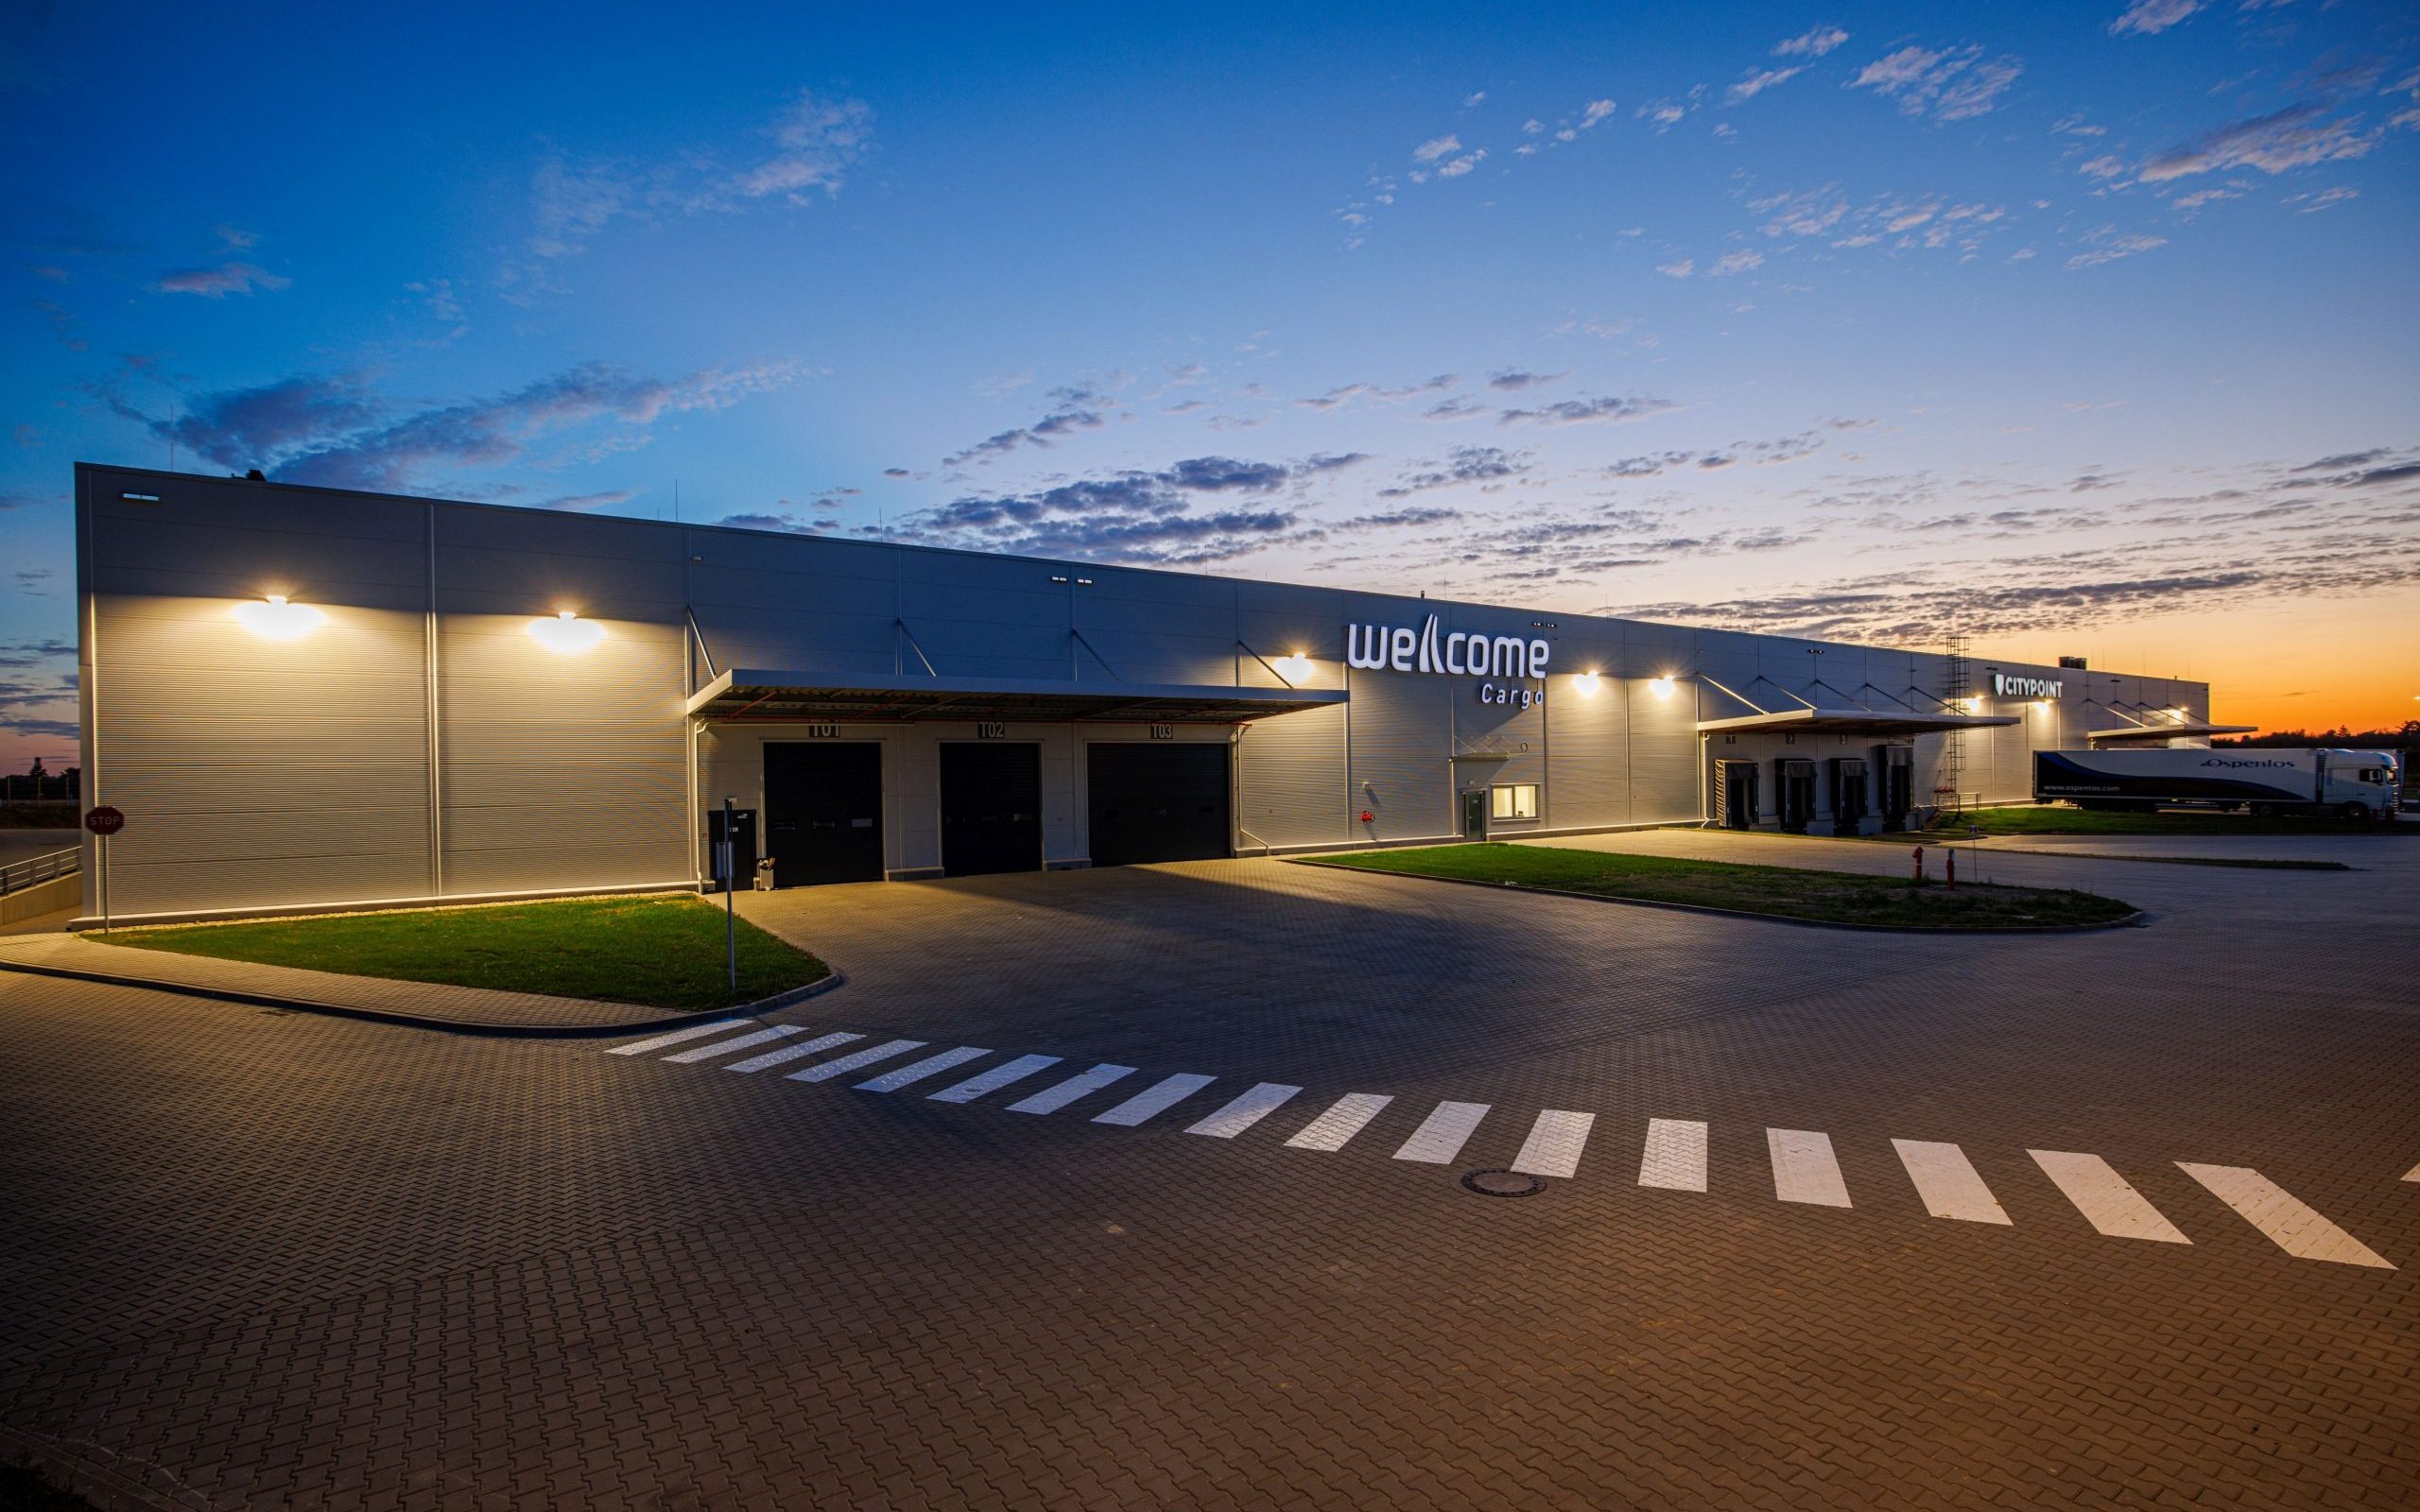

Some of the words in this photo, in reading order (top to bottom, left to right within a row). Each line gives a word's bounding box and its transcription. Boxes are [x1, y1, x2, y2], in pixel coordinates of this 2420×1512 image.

[1348, 613, 1549, 679] wellcome
[1481, 683, 1544, 709] Cargo
[2005, 676, 2063, 698] CITYPOINT
[978, 721, 1004, 738] T02
[1151, 723, 1172, 739] T03
[90, 816, 120, 826] STOP
